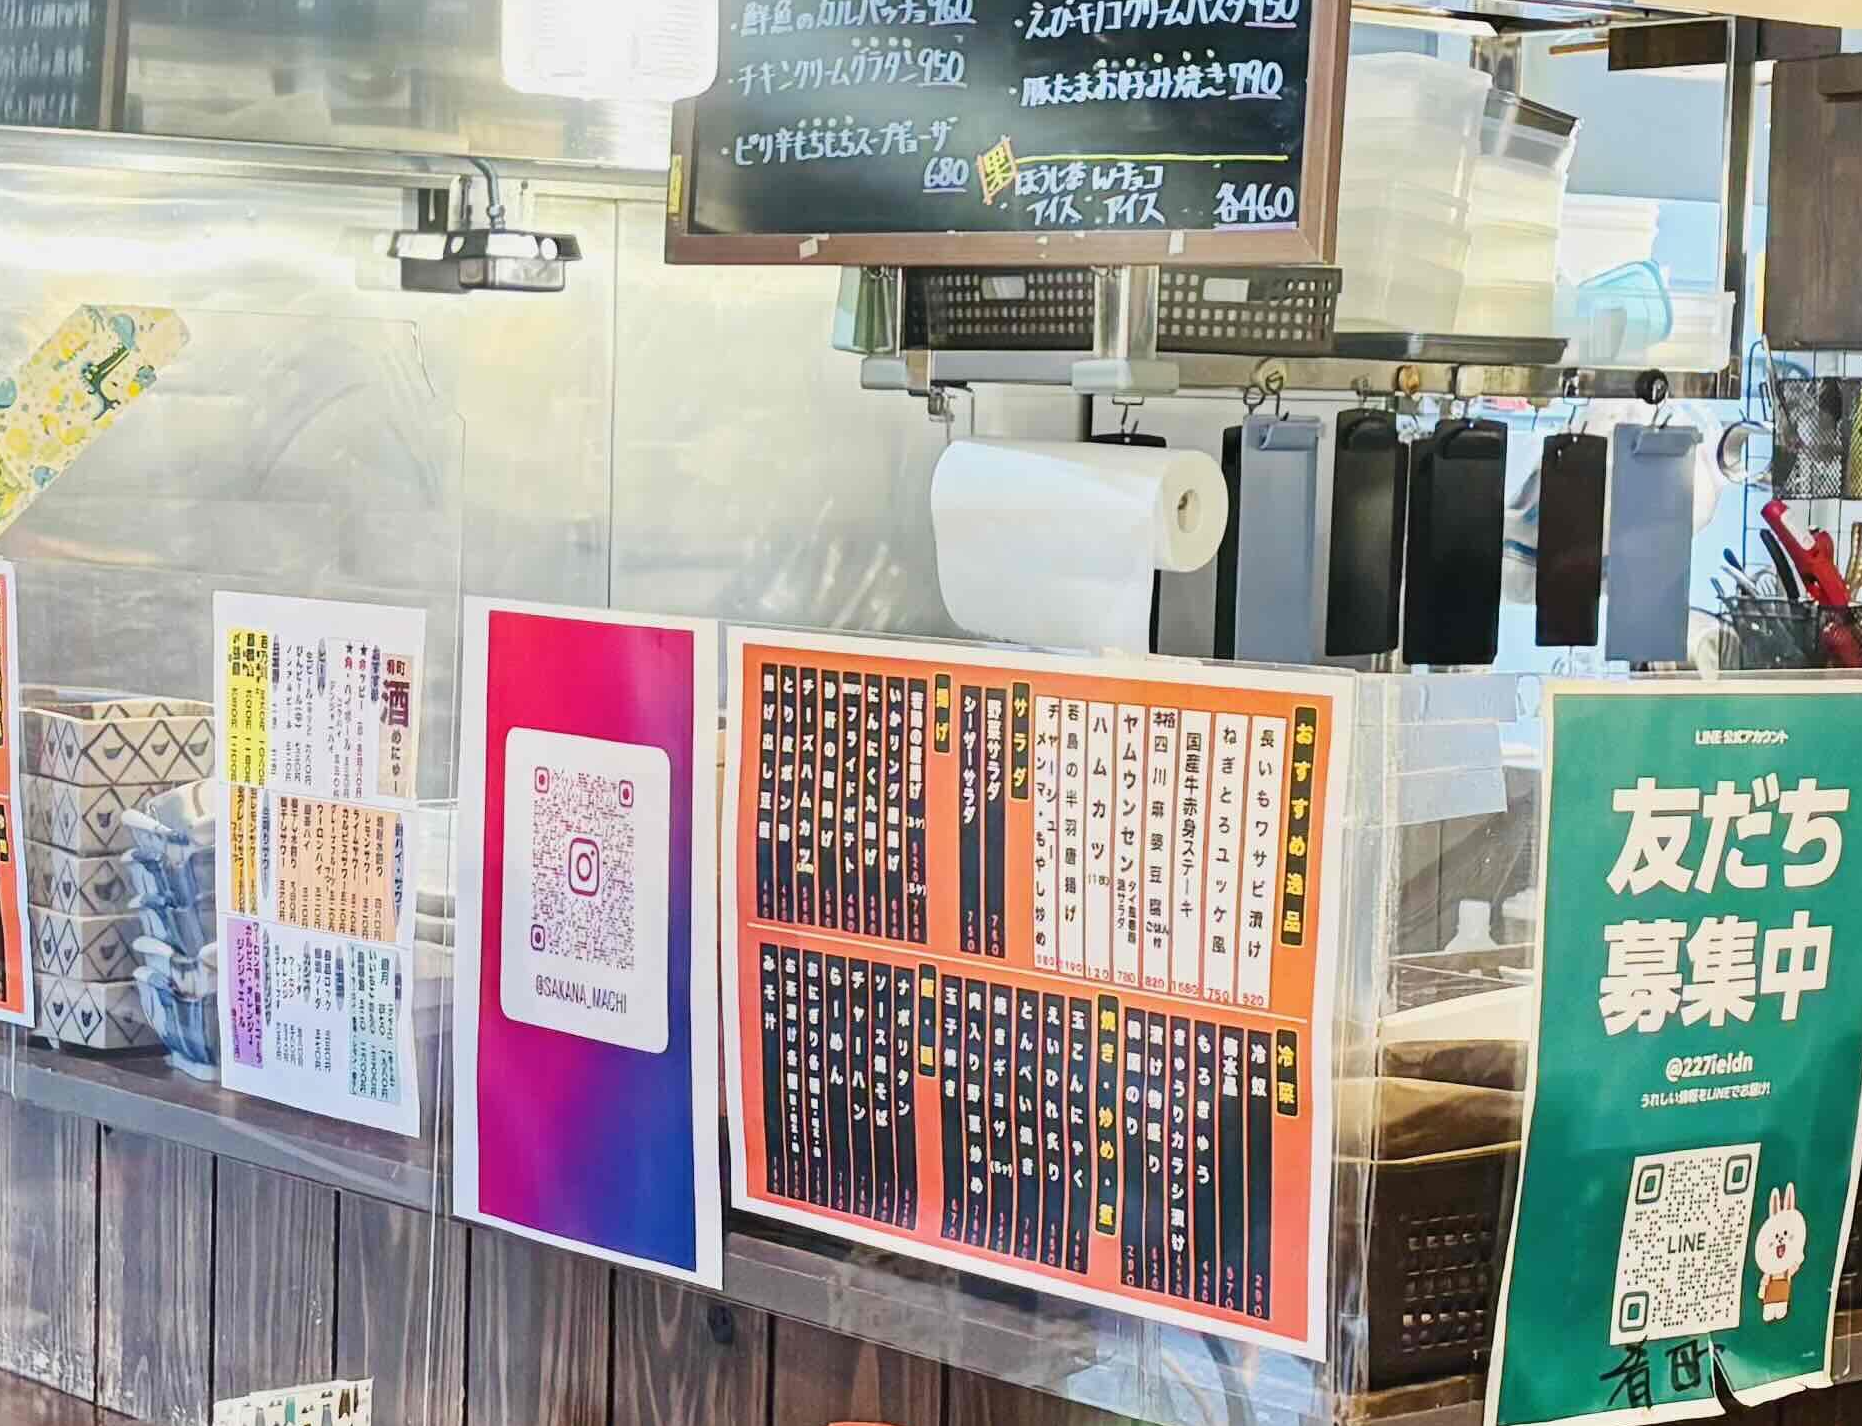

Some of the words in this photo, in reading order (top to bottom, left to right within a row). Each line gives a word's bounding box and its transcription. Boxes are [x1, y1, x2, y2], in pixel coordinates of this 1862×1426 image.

[917, 51, 965, 88] 950
[1227, 59, 1284, 95] 790
[923, 156, 969, 190] 680
[1032, 194, 1081, 224] アイス
[1105, 193, 1165, 224] アイス
[379, 679, 411, 729] 酒
[1012, 696, 1029, 788] サラダ
[1694, 729, 1722, 747] LINE
[1090, 716, 1109, 863] ハムカツ
[1605, 772, 1850, 897] 友だち
[1598, 908, 1834, 1038] 募集中
[533, 973, 629, 1016] @SAKANA_MACHI
[1667, 1231, 1706, 1256] LINE
